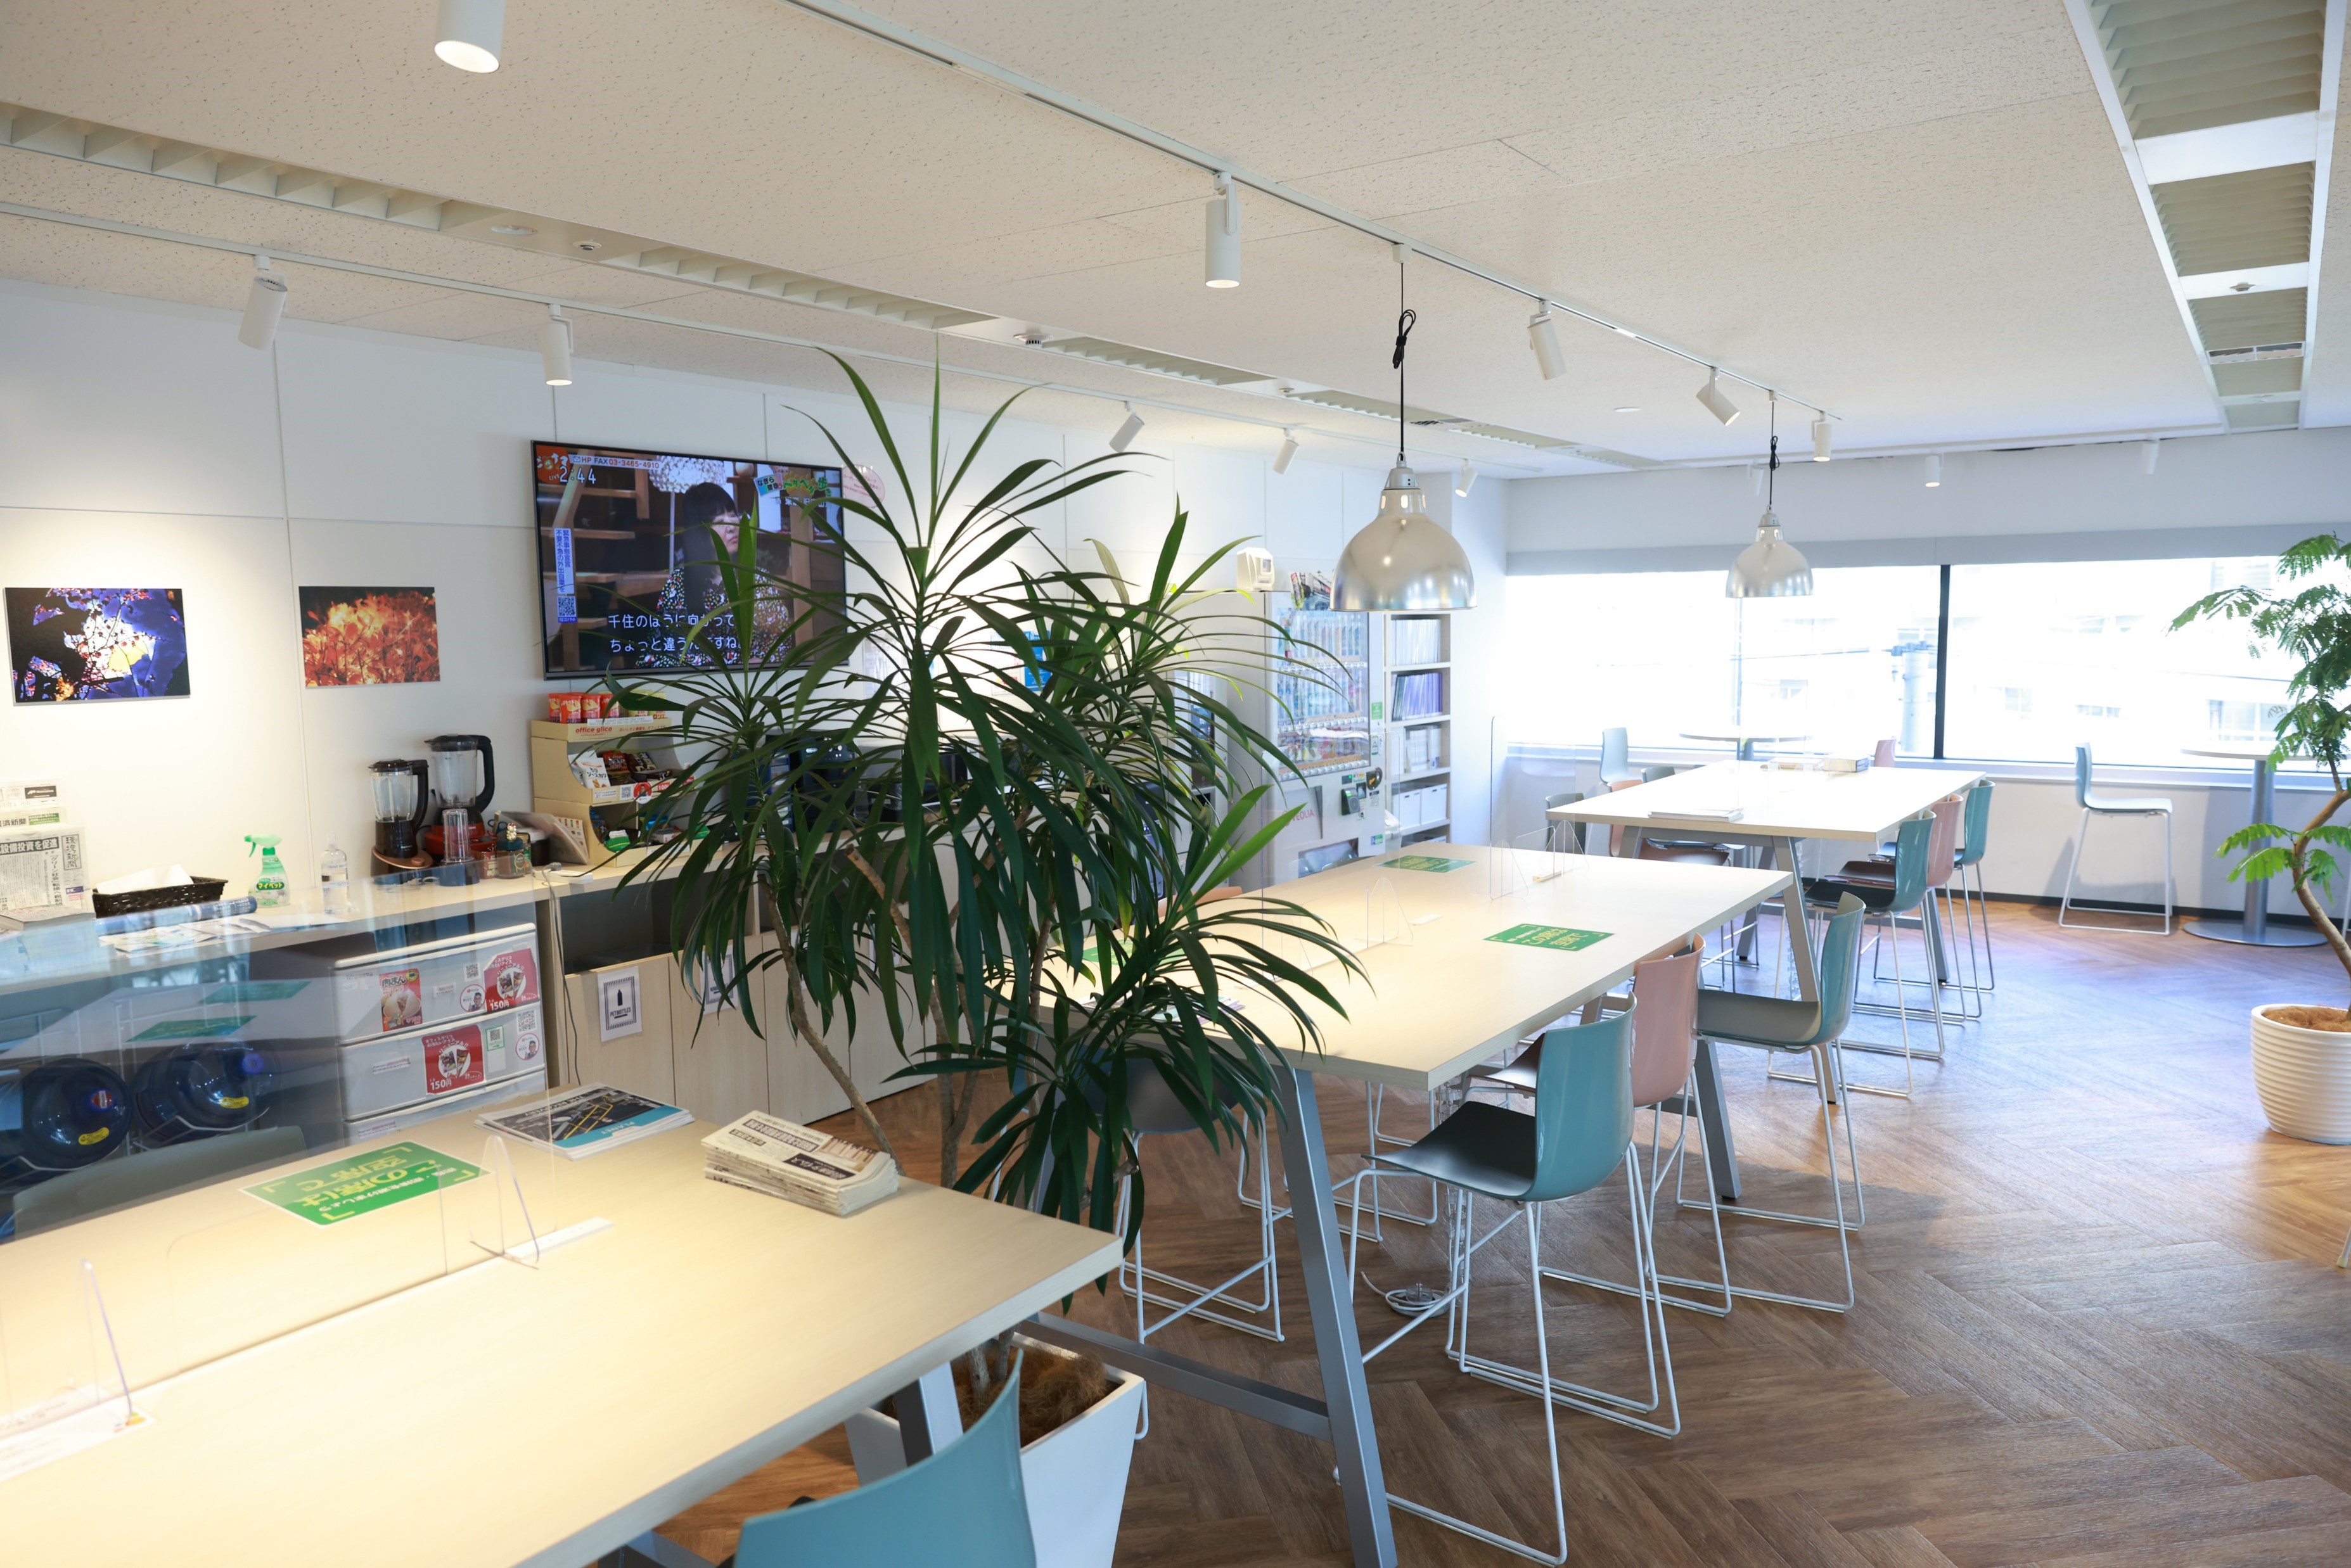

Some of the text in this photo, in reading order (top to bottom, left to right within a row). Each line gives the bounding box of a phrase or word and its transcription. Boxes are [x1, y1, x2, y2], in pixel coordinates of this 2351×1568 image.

[609, 459, 660, 469] 03-3465-4910
[560, 466, 596, 484] 2:44
[0, 818, 26, 827] 済新聞
[0, 838, 58, 855] 設備投資を促進
[65, 836, 77, 868] 環境新聞
[382, 976, 406, 987] 肉まん
[490, 1000, 509, 1011] 150円
[617, 1007, 631, 1016] BOTTLES
[430, 1079, 452, 1090] 150円
[292, 1159, 442, 1208] この席は
